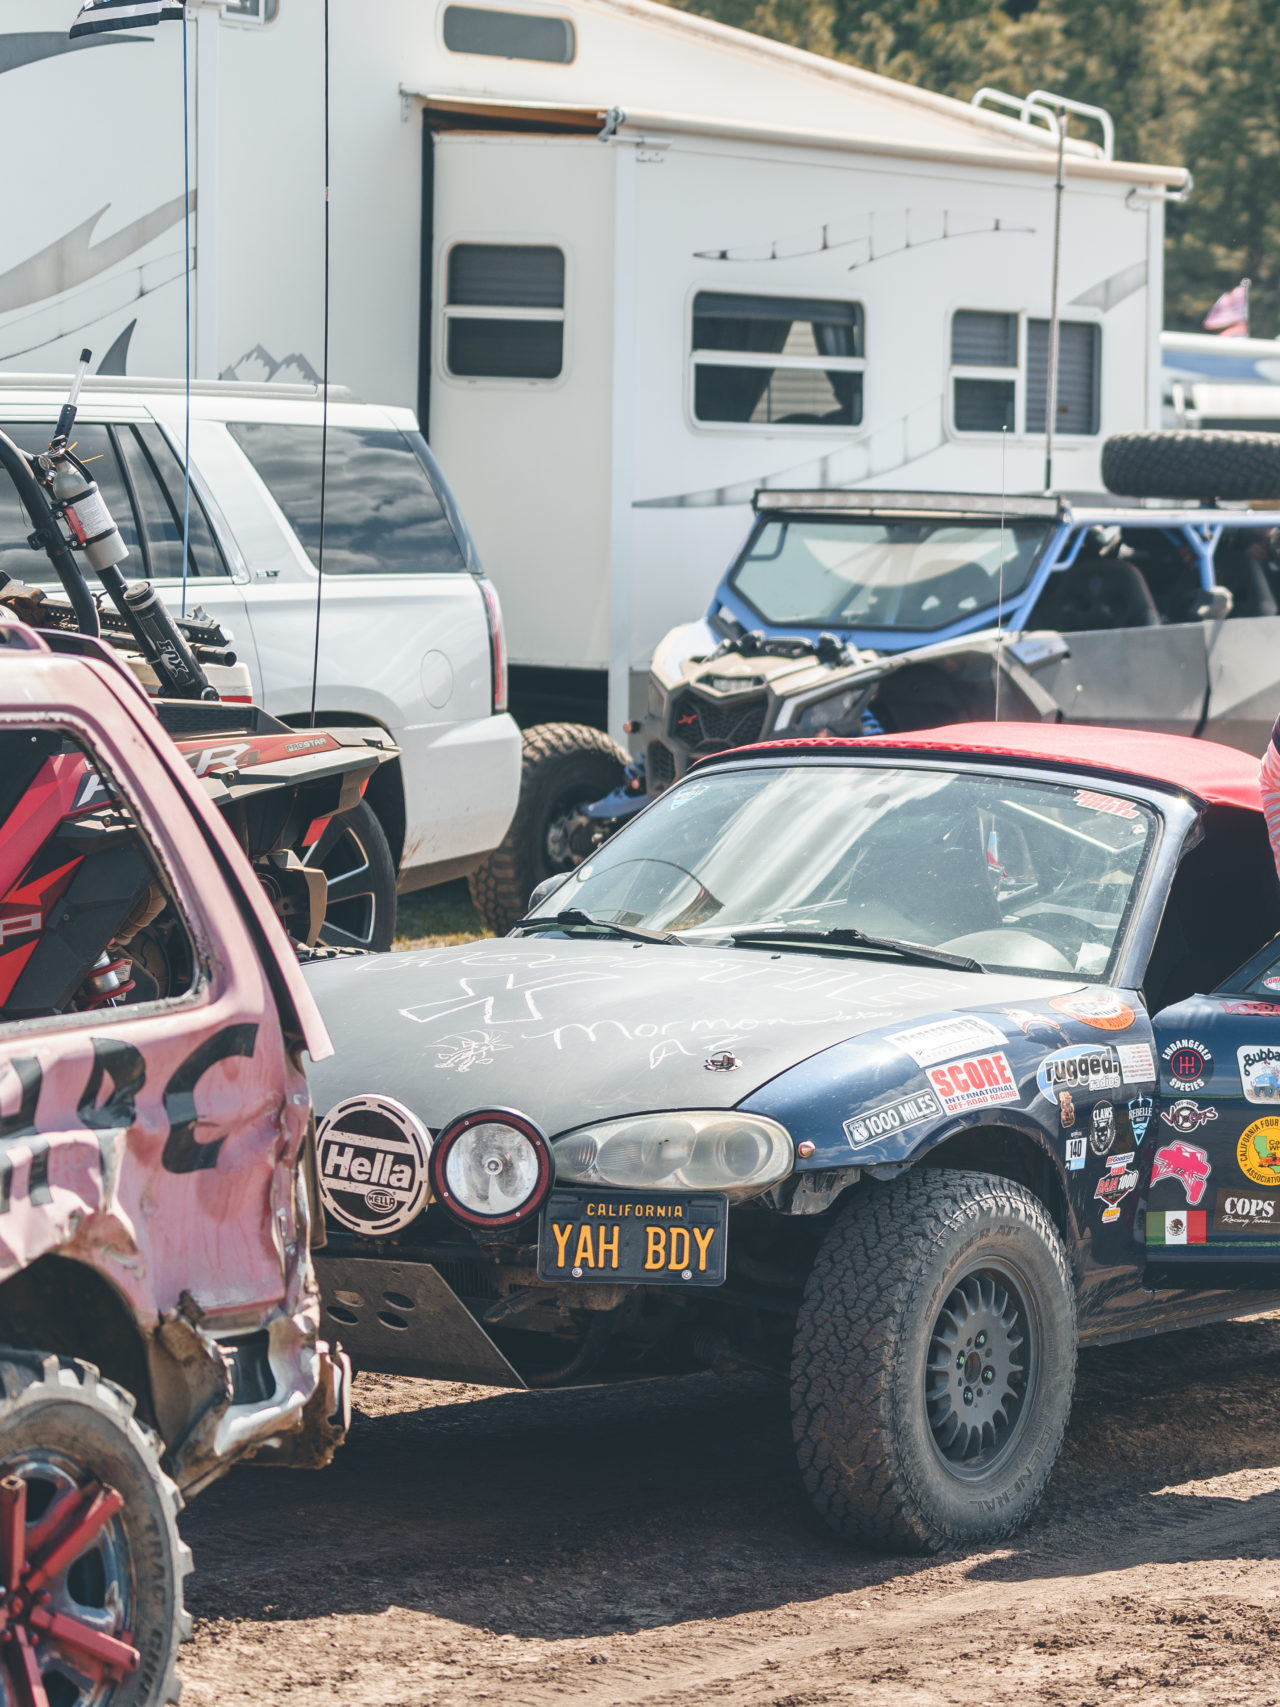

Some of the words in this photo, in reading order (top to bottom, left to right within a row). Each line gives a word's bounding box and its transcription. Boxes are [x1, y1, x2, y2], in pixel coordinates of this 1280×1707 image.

[157, 639, 189, 678] FOX
[284, 737, 328, 753] PROSTAR
[1162, 1039, 1212, 1061] ENDANGERED
[930, 1055, 1012, 1098] SCORE
[1088, 1074, 1121, 1091] radios
[1169, 1077, 1206, 1092] SPECIES
[944, 1085, 1014, 1105] INTERNATIONAL
[947, 1097, 988, 1111] OFF-ROAD
[990, 1090, 1018, 1104] RACING
[865, 1109, 901, 1136] 1000
[898, 1094, 938, 1122] MILES
[1092, 1106, 1113, 1121] CLAWS
[1128, 1107, 1153, 1120] REBELLE
[1070, 1140, 1082, 1158] 140
[1239, 1123, 1261, 1162] CALIFORNIA
[1260, 1118, 1279, 1129] FOUR
[323, 1144, 413, 1189] Hella
[1096, 1177, 1119, 1195] BAJA
[1117, 1171, 1138, 1191] 1000
[368, 1195, 396, 1207] HELLA
[586, 1203, 683, 1218] CALIFORNIA
[1224, 1196, 1277, 1218] COPS
[1222, 1214, 1250, 1228] Racing
[552, 1223, 621, 1269] YAH
[644, 1226, 716, 1272] BDY
[968, 1423, 1054, 1514] GENERAL
